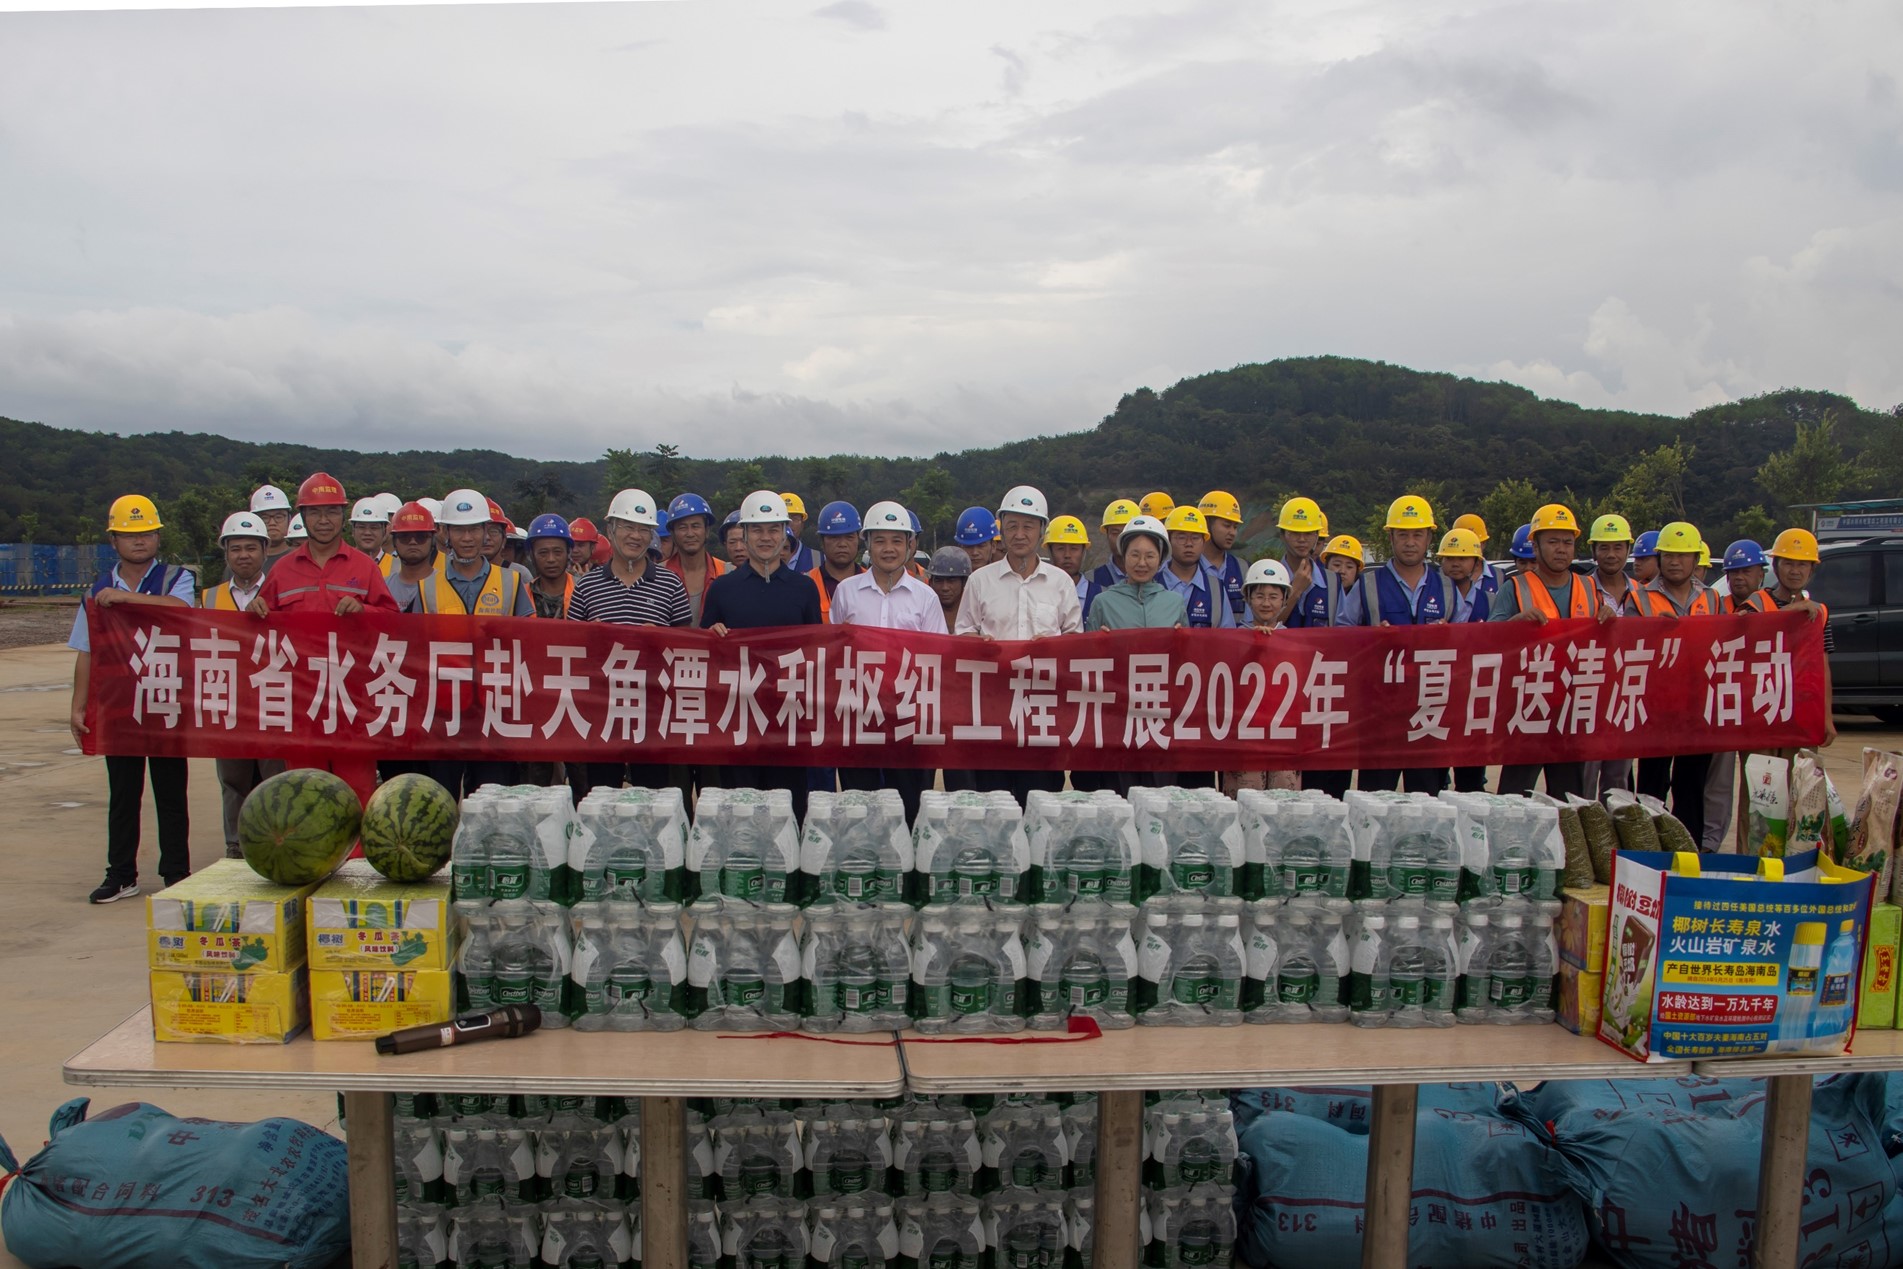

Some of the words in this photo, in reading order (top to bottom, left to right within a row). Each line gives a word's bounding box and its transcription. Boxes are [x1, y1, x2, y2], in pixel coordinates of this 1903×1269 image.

[199, 936, 241, 948] 冬瓜茶
[1669, 937, 1777, 956] 火山岩矿泉水
[1666, 963, 1778, 978] 产自世界长寿岛海南岛
[1661, 993, 1774, 1011] 水龄达到一万九千年
[1260, 1090, 1296, 1114] 313
[191, 1185, 236, 1208] 313
[1277, 1211, 1318, 1233] 313
